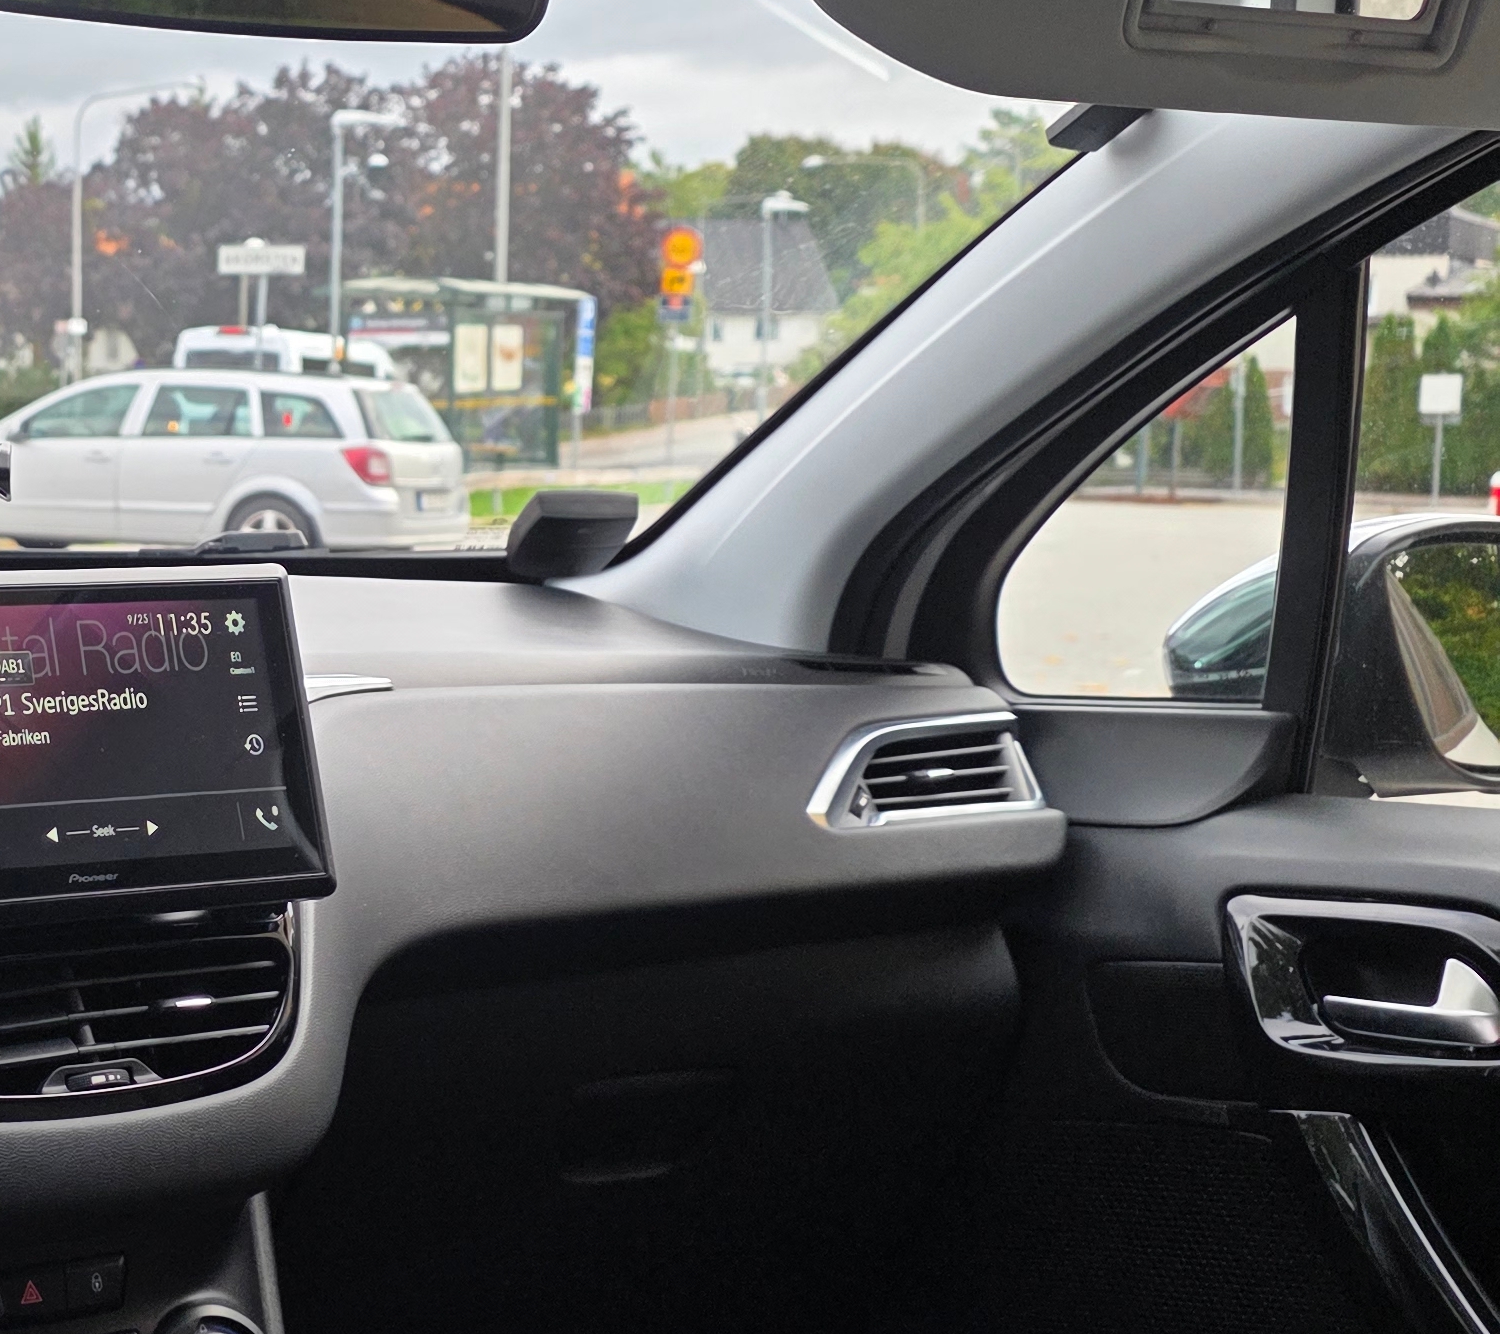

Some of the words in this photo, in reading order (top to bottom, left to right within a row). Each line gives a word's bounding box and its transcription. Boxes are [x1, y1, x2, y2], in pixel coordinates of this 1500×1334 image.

[126, 613, 149, 626] 9/25
[156, 612, 212, 636] 11:35
[76, 612, 208, 676] Radio
[21, 687, 148, 715] SverigesRadio
[92, 824, 116, 837] Seek
